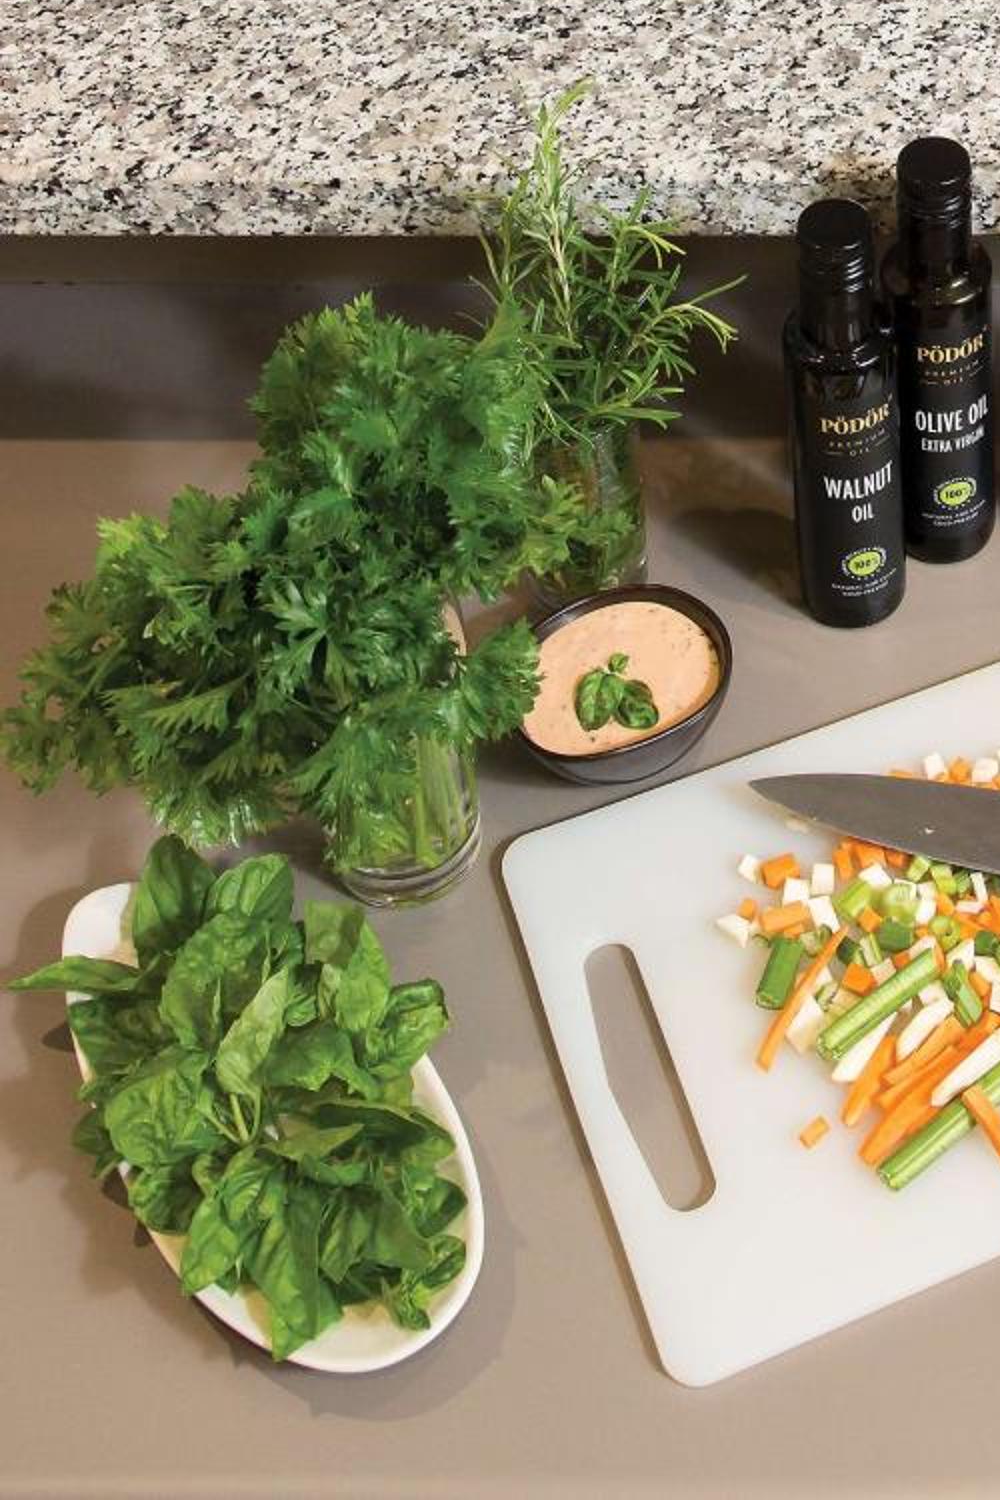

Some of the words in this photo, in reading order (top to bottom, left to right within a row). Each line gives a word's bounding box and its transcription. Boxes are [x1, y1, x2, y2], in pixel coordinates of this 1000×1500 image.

[917, 333, 983, 363] PÖDÖR
[820, 403, 889, 435] PÖDÖR
[915, 408, 963, 433] OLIVE
[968, 393, 989, 425] OIL
[921, 437, 953, 453] EXTRA
[823, 459, 893, 501] WALNUT
[851, 502, 874, 523] OIL
